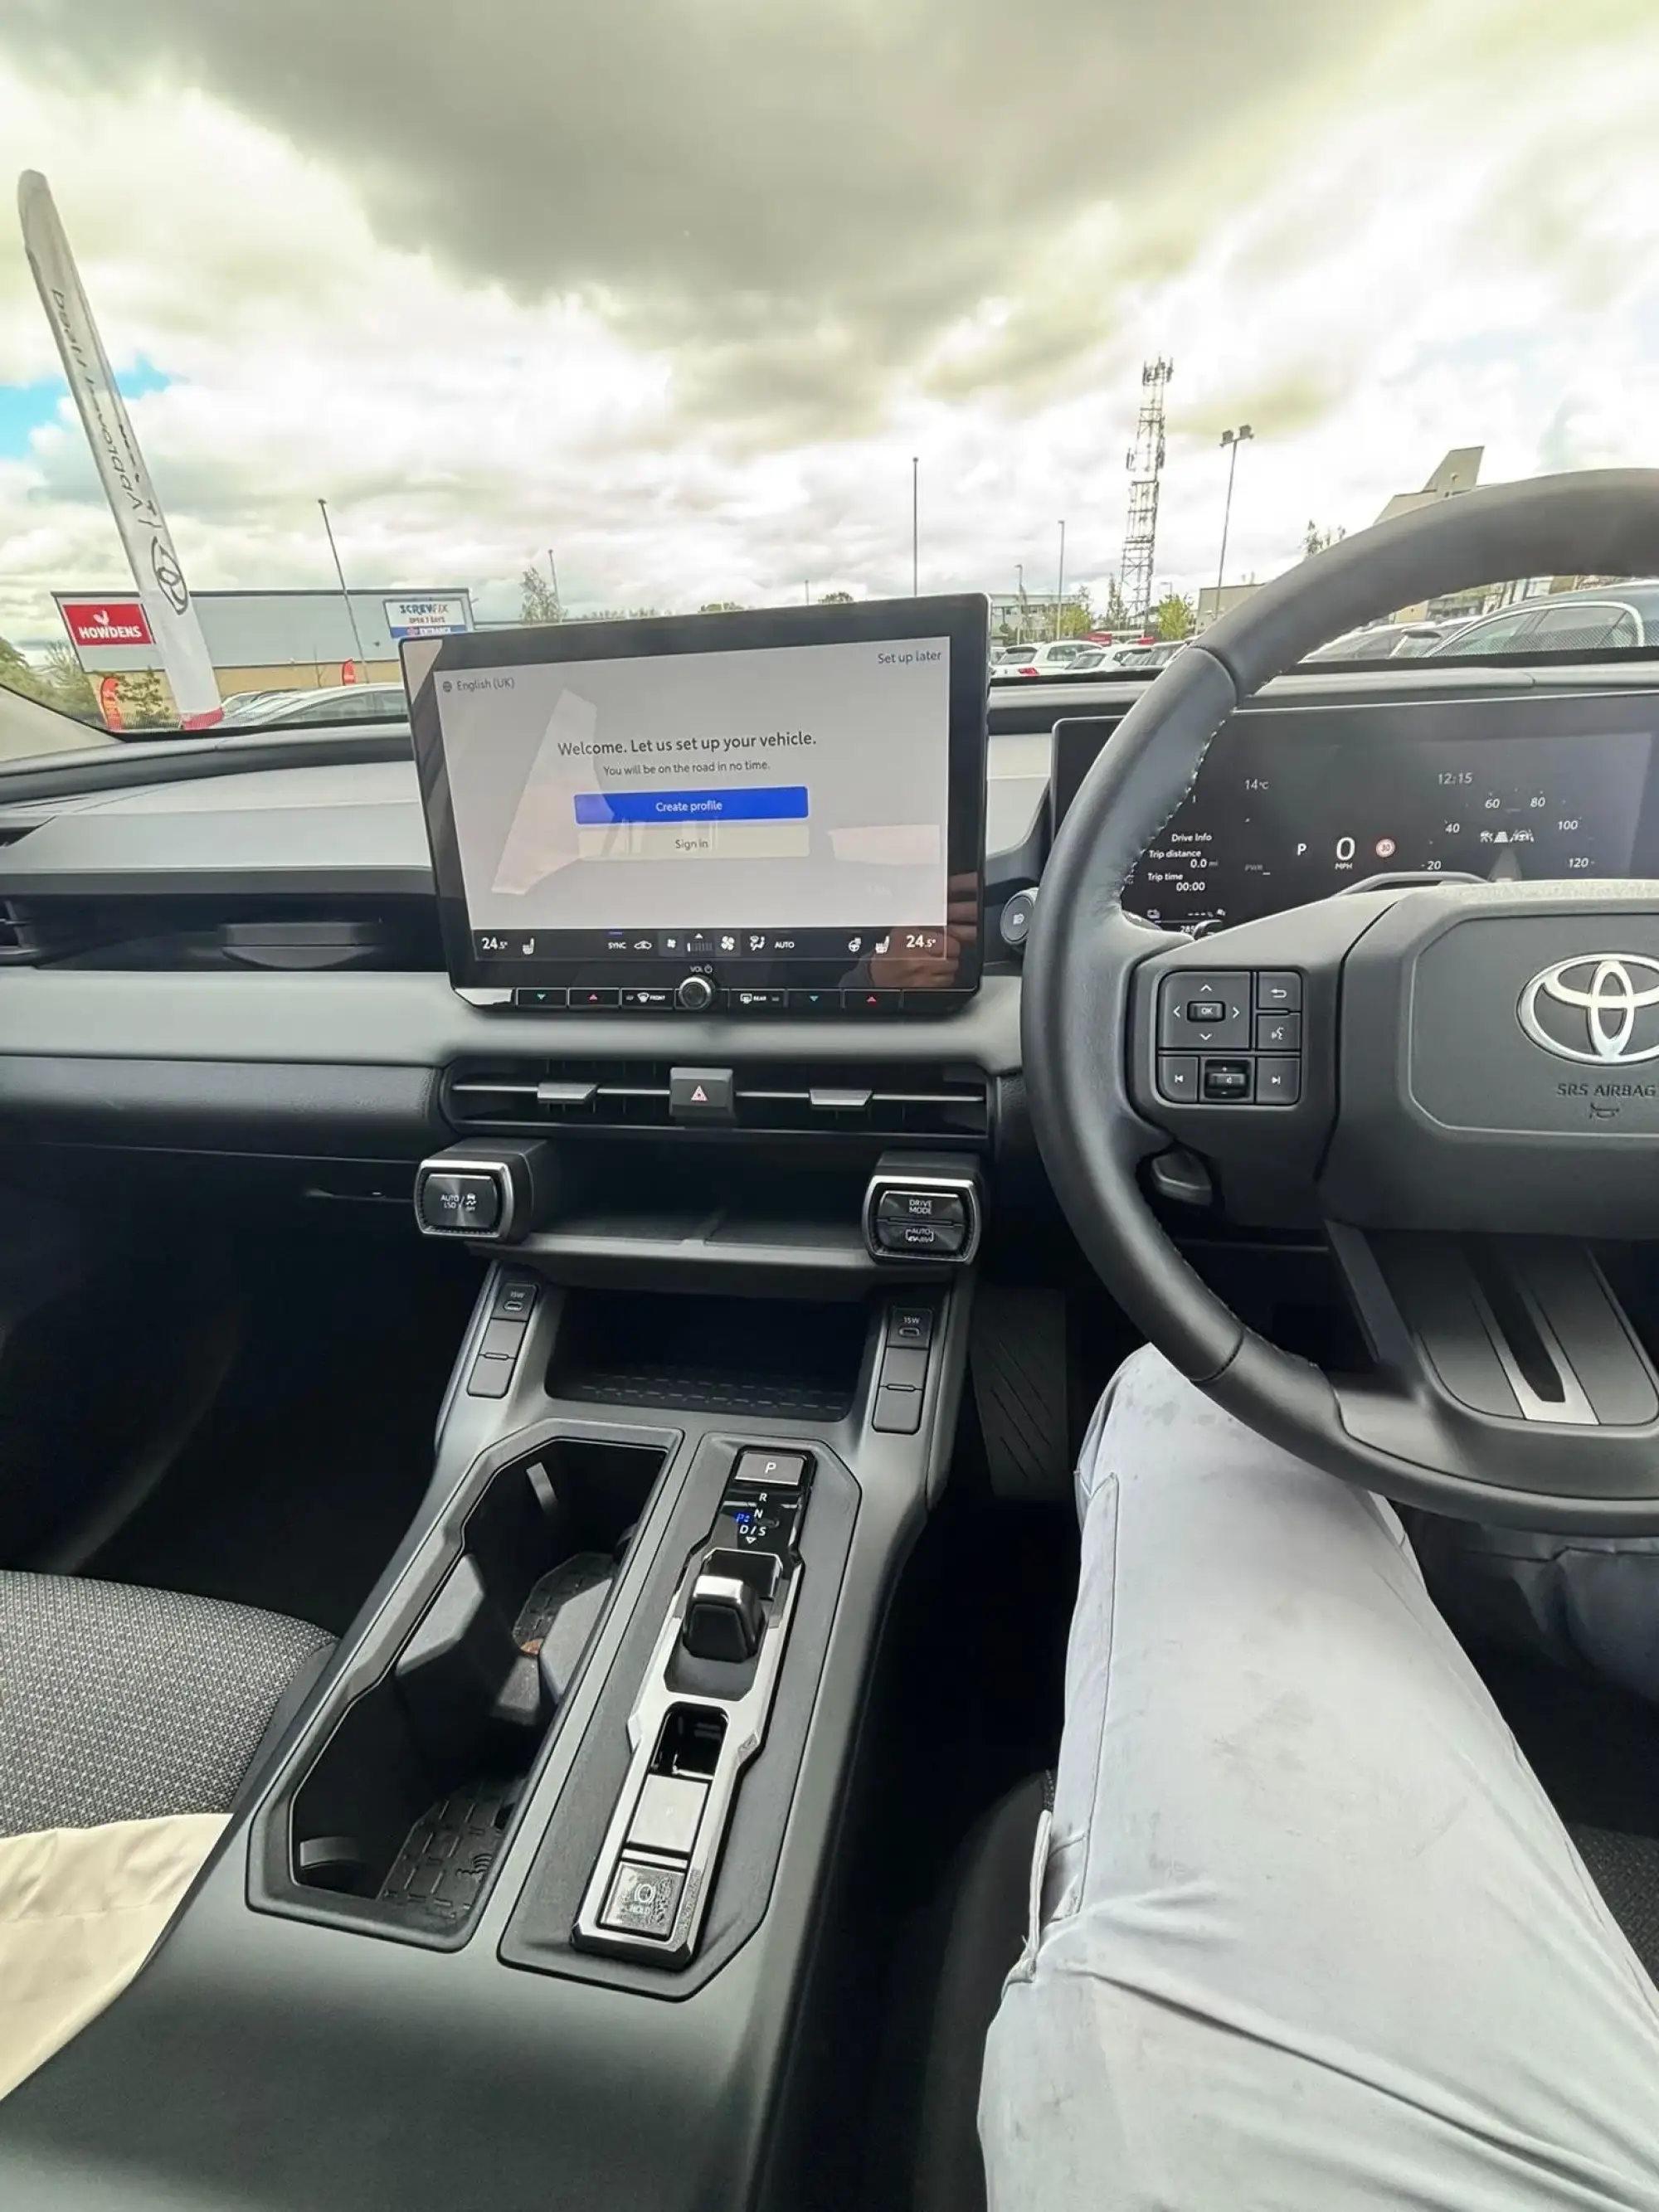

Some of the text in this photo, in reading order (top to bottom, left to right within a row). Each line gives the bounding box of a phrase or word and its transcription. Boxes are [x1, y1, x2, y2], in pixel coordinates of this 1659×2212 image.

[78, 625, 143, 639] HOWDENS
[878, 650, 941, 665] Set up later
[457, 677, 514, 693] English (UK)
[558, 731, 816, 756] Welcome. Let us set up your vehicle.
[604, 766, 621, 776] You
[624, 764, 641, 775] will
[644, 764, 656, 775] be
[658, 765, 672, 773] on
[674, 763, 690, 773] the
[692, 761, 715, 772] road
[718, 761, 727, 771] in
[745, 760, 770, 771] time.
[1438, 772, 1473, 785] 12:15
[656, 800, 722, 814] Create profile
[1485, 798, 1500, 809] 60
[1530, 797, 1545, 808] 80
[1445, 823, 1460, 834] 40
[1557, 819, 1579, 830] 100
[1171, 833, 1212, 842] Drive Info
[675, 839, 708, 851] Sign in
[1297, 843, 1307, 856] P
[1336, 837, 1355, 861] 0
[1149, 849, 1202, 859] Trip distance
[1190, 858, 1207, 868] 0.0
[1428, 860, 1442, 871] 20
[1569, 858, 1588, 869] 120
[1148, 873, 1184, 882] Trip time
[1176, 882, 1205, 892] 00:00
[608, 941, 626, 950] SYNC
[1201, 1007, 1214, 1015] OK
[1556, 1083, 1657, 1097] SRS AIRBAG
[909, 1207, 931, 1215] MODE
[765, 1462, 776, 1474] P
[759, 1493, 767, 1502] R
[754, 1509, 763, 1519] N
